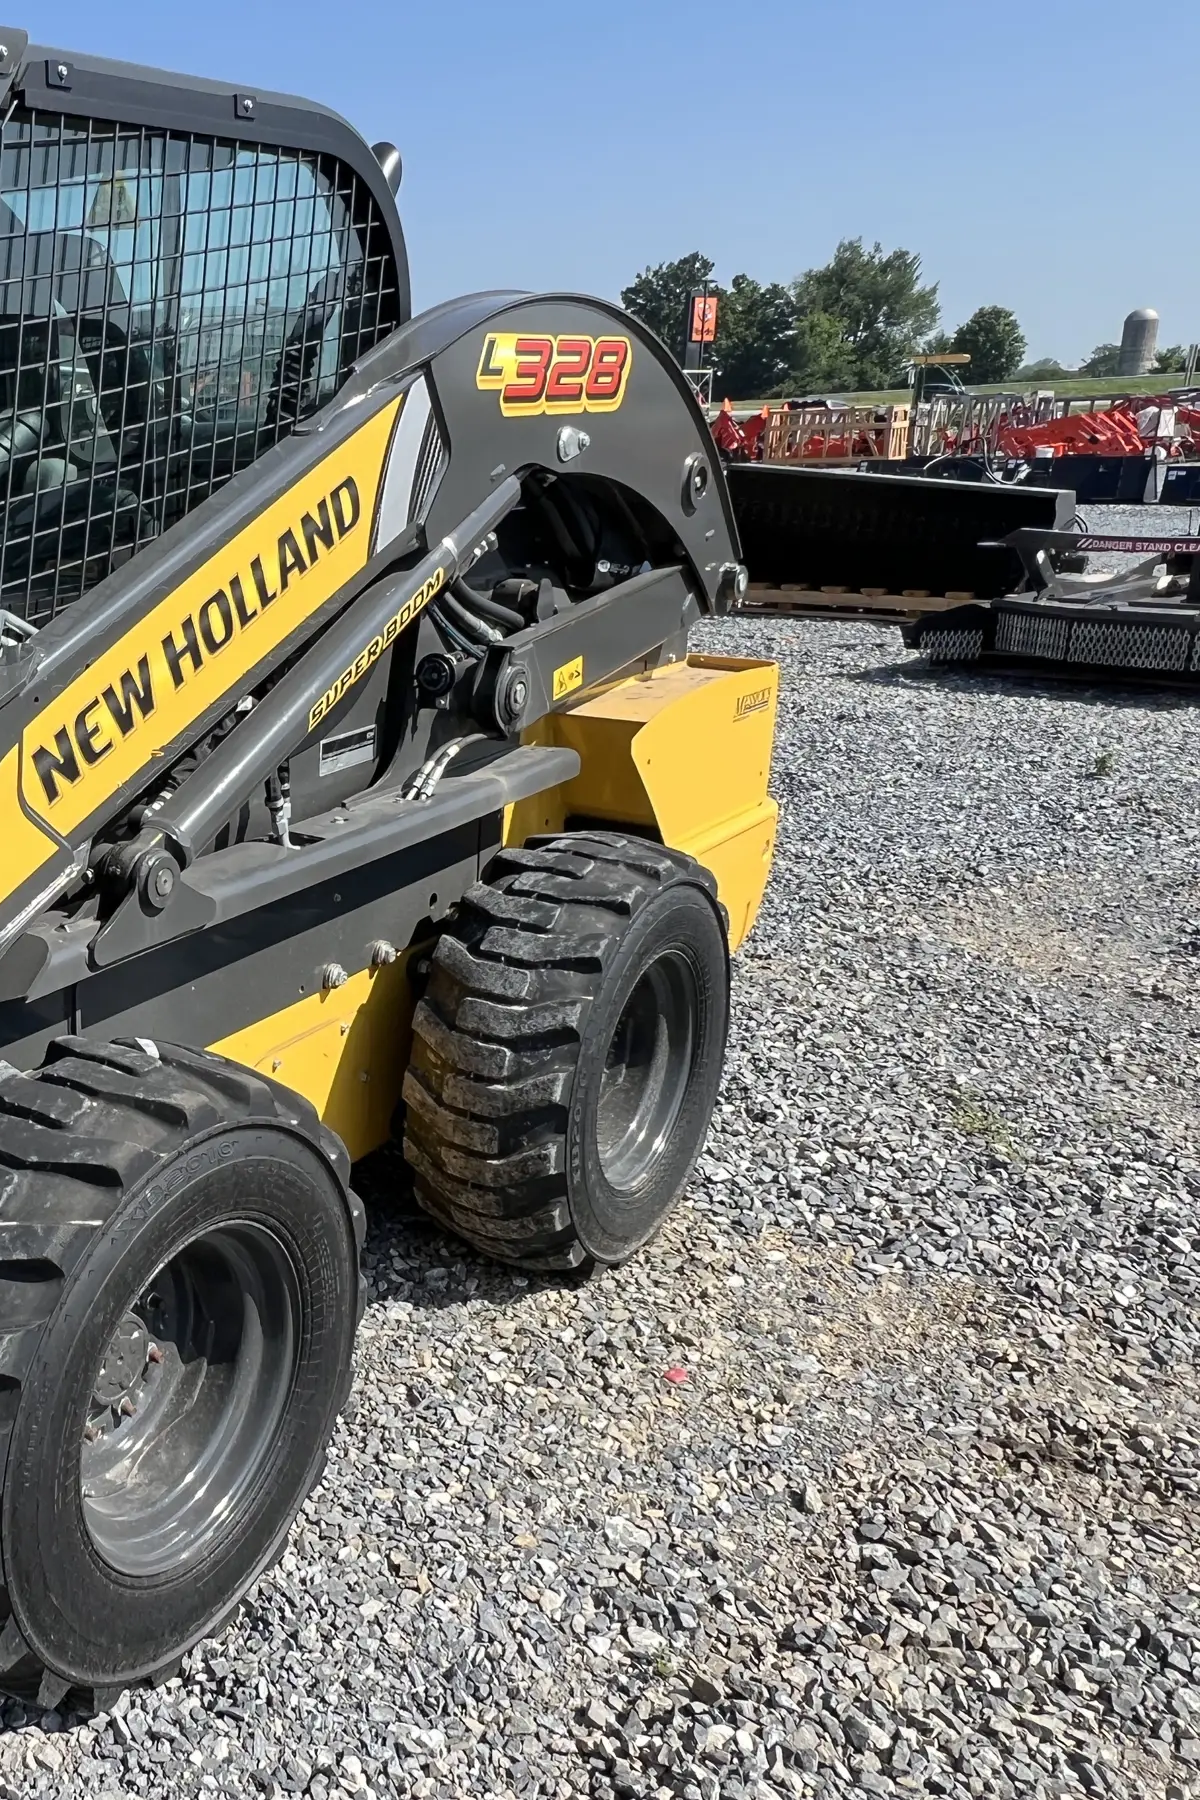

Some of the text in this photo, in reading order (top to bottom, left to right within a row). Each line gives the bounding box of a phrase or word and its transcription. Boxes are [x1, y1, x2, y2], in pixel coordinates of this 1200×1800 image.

[477, 333, 632, 416] L328
[1093, 540, 1133, 550] DANGER
[1135, 542, 1172, 551] STAND
[31, 475, 361, 804] NEW HOLLAND
